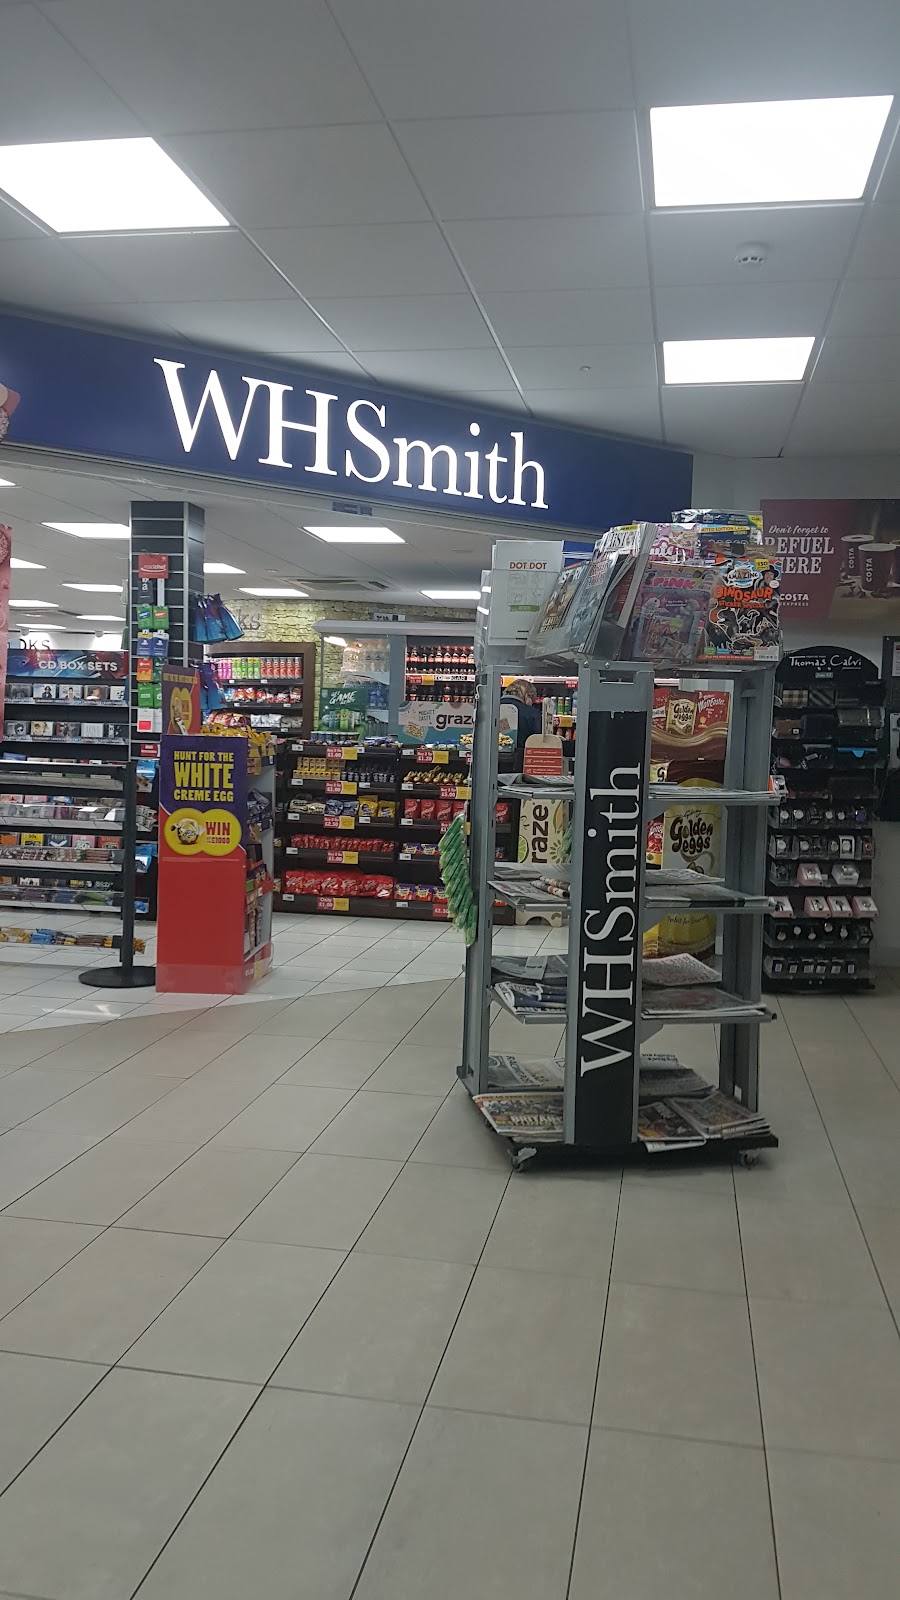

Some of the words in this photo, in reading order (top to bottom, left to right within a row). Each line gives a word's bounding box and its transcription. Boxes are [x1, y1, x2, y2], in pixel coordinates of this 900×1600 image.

[153, 357, 549, 510] WHSmith
[769, 525, 792, 534] Don't
[793, 525, 819, 537] forget
[509, 562, 528, 570] DOT
[529, 562, 547, 570] DOT
[780, 556, 822, 574] ERE
[728, 569, 759, 580] AMAZING
[713, 585, 773, 601] DINOSAUR
[780, 593, 809, 601] COSTA
[39, 660, 57, 670] CD
[60, 661, 85, 670] BOX
[88, 661, 118, 672] SETS
[789, 655, 827, 667] Thomas
[829, 655, 862, 667] Calvi
[329, 690, 358, 705] GAME
[673, 702, 694, 719] Golden
[174, 750, 198, 761] HUNT
[198, 751, 216, 762] FOR
[217, 752, 234, 762] THE
[173, 761, 234, 789] WHITE
[173, 789, 212, 801] CREME
[213, 790, 234, 803] EGG
[205, 821, 231, 836] WIN
[531, 804, 549, 864] raze
[670, 816, 714, 853] Golden
[682, 835, 711, 854] eggs
[580, 761, 641, 1078] WHSmith
